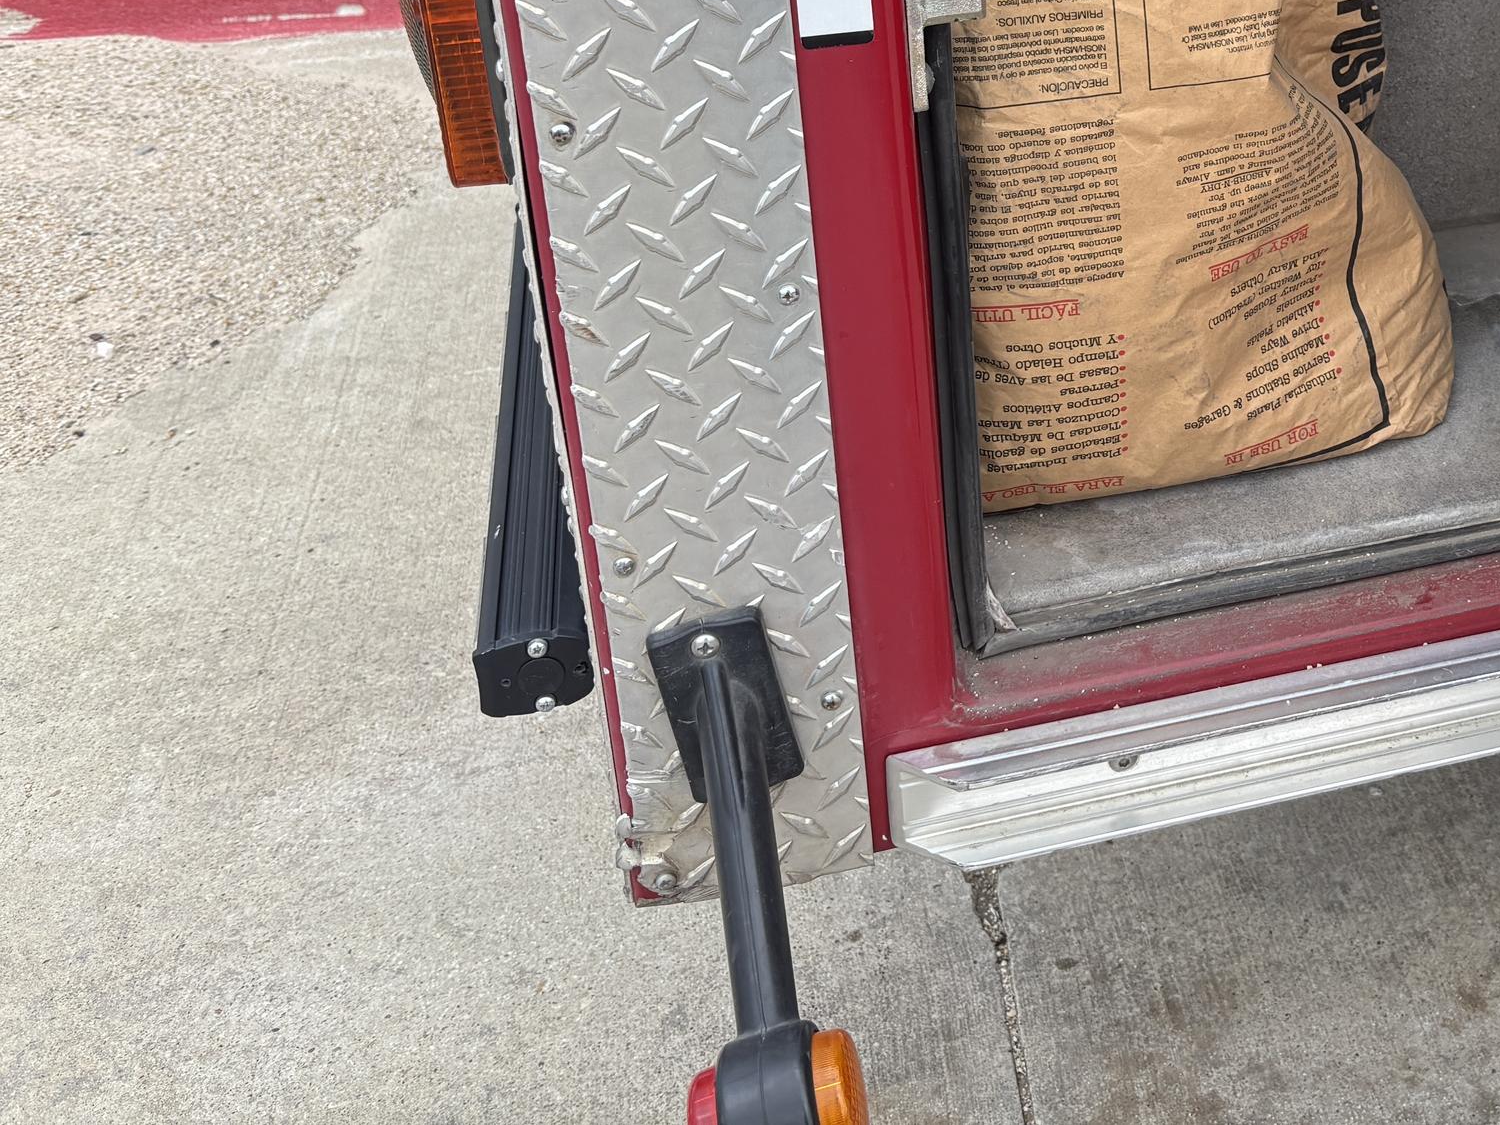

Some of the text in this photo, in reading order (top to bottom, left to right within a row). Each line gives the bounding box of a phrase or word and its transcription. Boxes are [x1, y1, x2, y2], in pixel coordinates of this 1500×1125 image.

[995, 9, 1104, 27] PRIMEROS AUXILIOS:
[1181, 27, 1242, 44] Conditions Exist Or
[1054, 44, 1106, 54] NIOSH/MSHA
[1188, 37, 1234, 52] NIOSH/MSHA
[978, 50, 1023, 63] respiradores
[995, 119, 1114, 138] regulaciones federales.
[1070, 129, 1115, 143] gastados
[987, 144, 1005, 152] con
[1009, 139, 1051, 150] acuerdo
[1054, 138, 1066, 146] de
[1246, 133, 1285, 148] granules
[1003, 150, 1050, 164] disponga
[1054, 149, 1061, 157] y
[1177, 145, 1230, 162] accordance
[1248, 154, 1285, 169] creating
[980, 154, 1116, 177] los buenos procedimientos
[1183, 151, 1255, 173] procedures and
[1274, 162, 1289, 174] pile
[1089, 181, 1100, 189] de
[1176, 172, 1210, 187] Always
[1244, 179, 1272, 193] sweep
[1054, 195, 1078, 203] para
[1082, 191, 1119, 201] barrido
[1208, 192, 1225, 202] For
[979, 205, 997, 213] que
[1001, 205, 1011, 213] El
[1187, 191, 1269, 220] work the granules
[1038, 224, 1121, 242] derramamientos
[1176, 246, 1214, 264] granules
[1211, 227, 1308, 282] EASY TO USE
[1268, 259, 1298, 274] Many
[1231, 273, 1263, 298] Others
[1258, 271, 1301, 295] Weather
[1243, 294, 1277, 321] Houses
[1276, 287, 1315, 313] Kennels
[1021, 303, 1080, 321] FÁCIL
[1208, 293, 1255, 330] (Traction)
[1247, 301, 1315, 347] Athletic Fields
[1006, 334, 1117, 353] Y Muchos Otros
[1260, 317, 1320, 355] Drive Ways
[1016, 358, 1063, 371] Helado
[1069, 349, 1119, 365] Tiempo
[1246, 335, 1325, 382] Machine Shops
[975, 365, 1119, 386] Casas De las Aves de
[1060, 379, 1119, 397] Perreras
[1184, 351, 1330, 431] Service Stations & Garages
[1247, 368, 1336, 421] Industrial Plants
[1002, 393, 1120, 414] Campos Atléticos
[1027, 419, 1050, 428] Las
[1056, 407, 1120, 425] Conduzca
[983, 421, 1121, 443] Tiendas De Máquina
[1051, 434, 1121, 454] Estaciones
[1225, 422, 1318, 466] FOR USE IN
[987, 448, 1121, 473] Plantas Industriales
[1030, 448, 1045, 460] de
[1002, 485, 1036, 498] USO
[1043, 485, 1066, 494] EL
[1073, 478, 1123, 491] PARA
